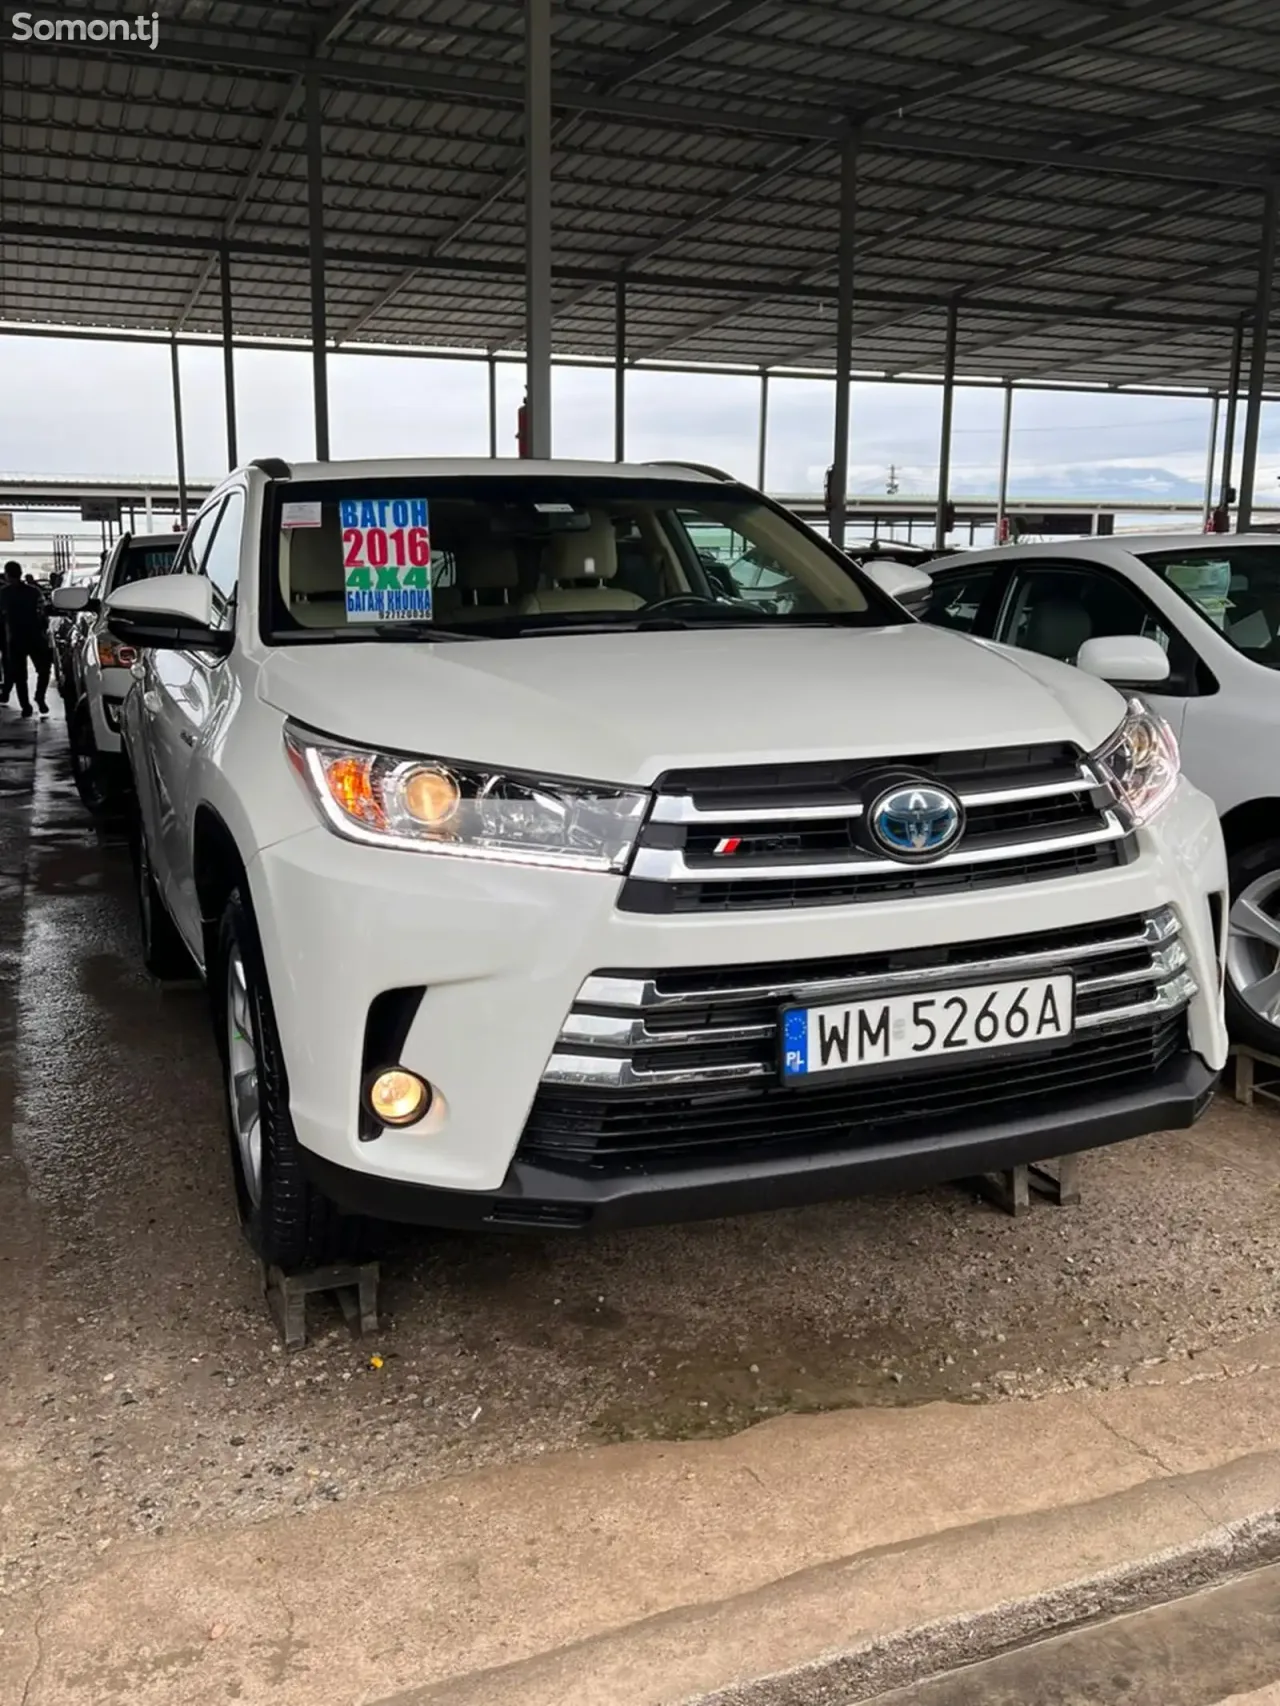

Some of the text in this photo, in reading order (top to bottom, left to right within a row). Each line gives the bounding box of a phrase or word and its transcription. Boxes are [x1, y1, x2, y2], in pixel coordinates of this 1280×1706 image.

[341, 500, 427, 528] ВАГОН
[343, 528, 429, 567] 2016
[347, 589, 431, 612] БАГАЖ КНОПКА
[818, 984, 1061, 1066] WM 5266A
[786, 1050, 804, 1066] PL
